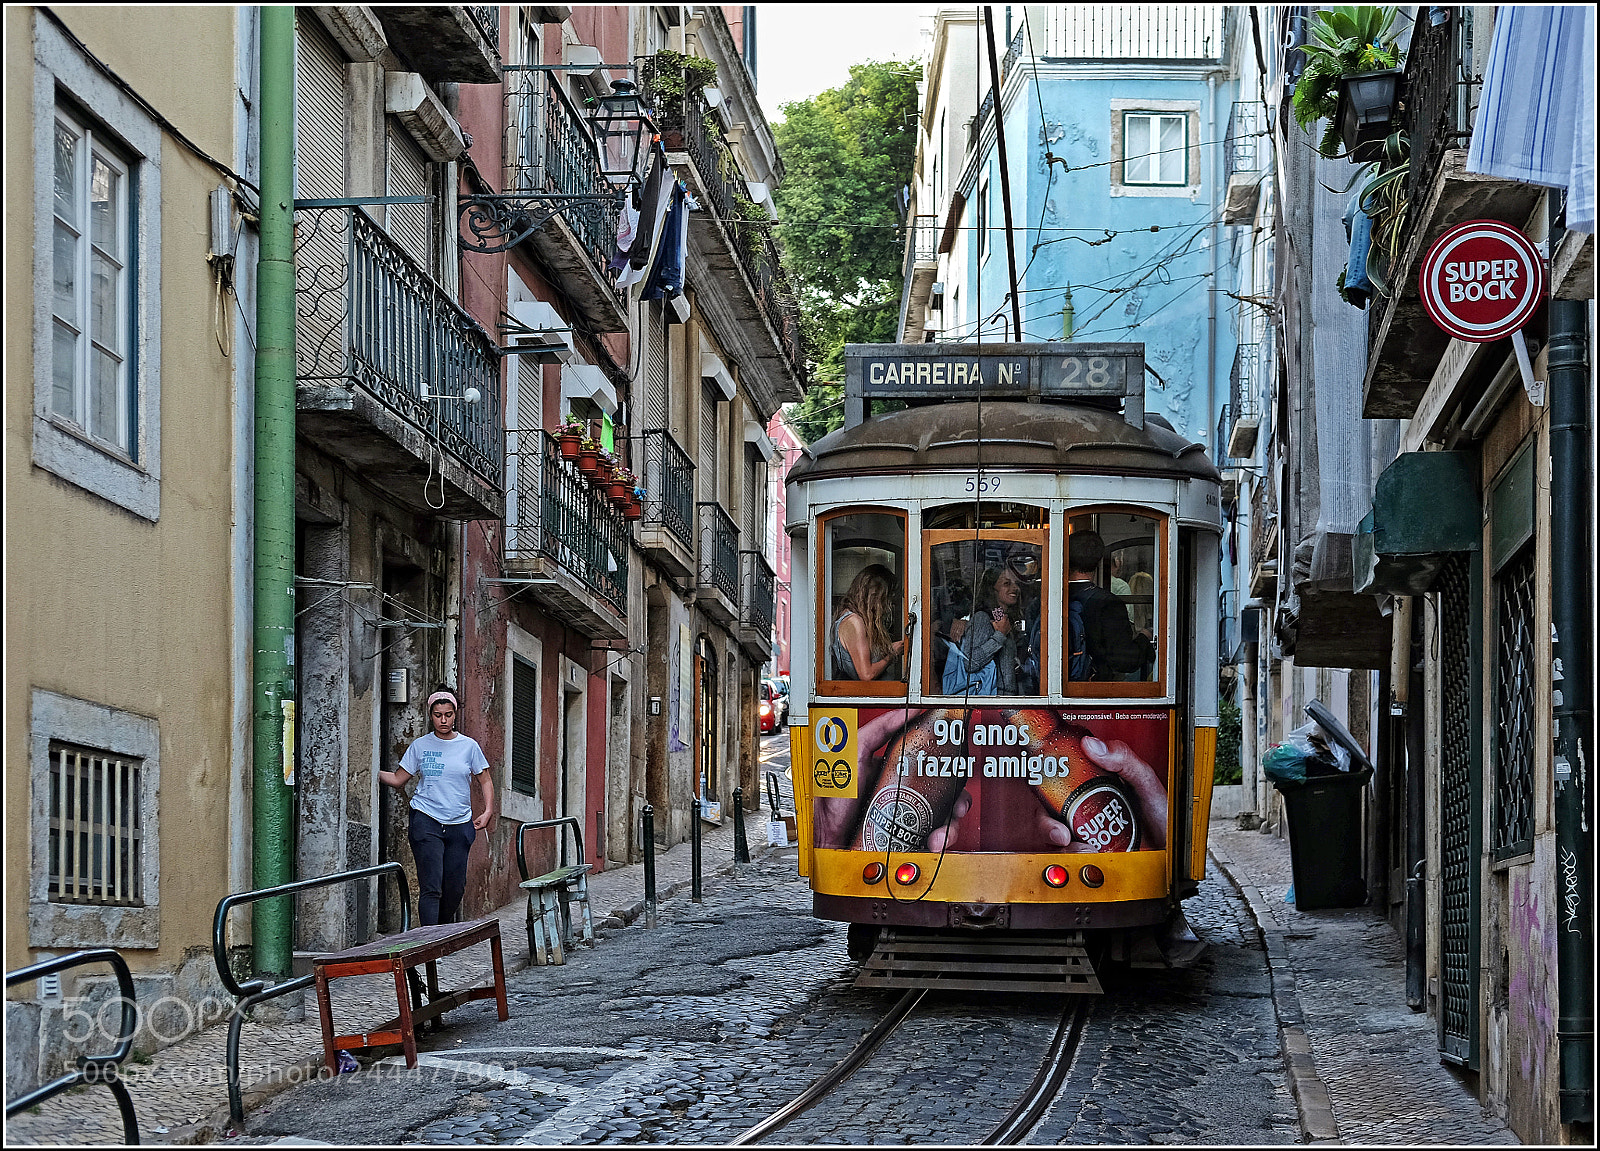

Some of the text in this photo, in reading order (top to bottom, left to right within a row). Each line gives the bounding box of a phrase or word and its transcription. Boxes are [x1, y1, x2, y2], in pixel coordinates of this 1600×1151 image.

[1445, 259, 1520, 283] SUPER
[1449, 280, 1517, 303] BOCK
[869, 362, 984, 385] CARREIRA
[1060, 356, 1111, 389] 28
[965, 476, 1001, 493] 559
[1062, 713, 1077, 721] Seja
[1115, 712, 1130, 720] Beba
[934, 719, 1030, 746] 90 anos
[896, 750, 1070, 786] a fazer amigos
[870, 808, 898, 836] SUPER
[1076, 798, 1123, 841] SUPER
[1087, 811, 1129, 851] BOCK
[896, 827, 922, 847] BOCK
